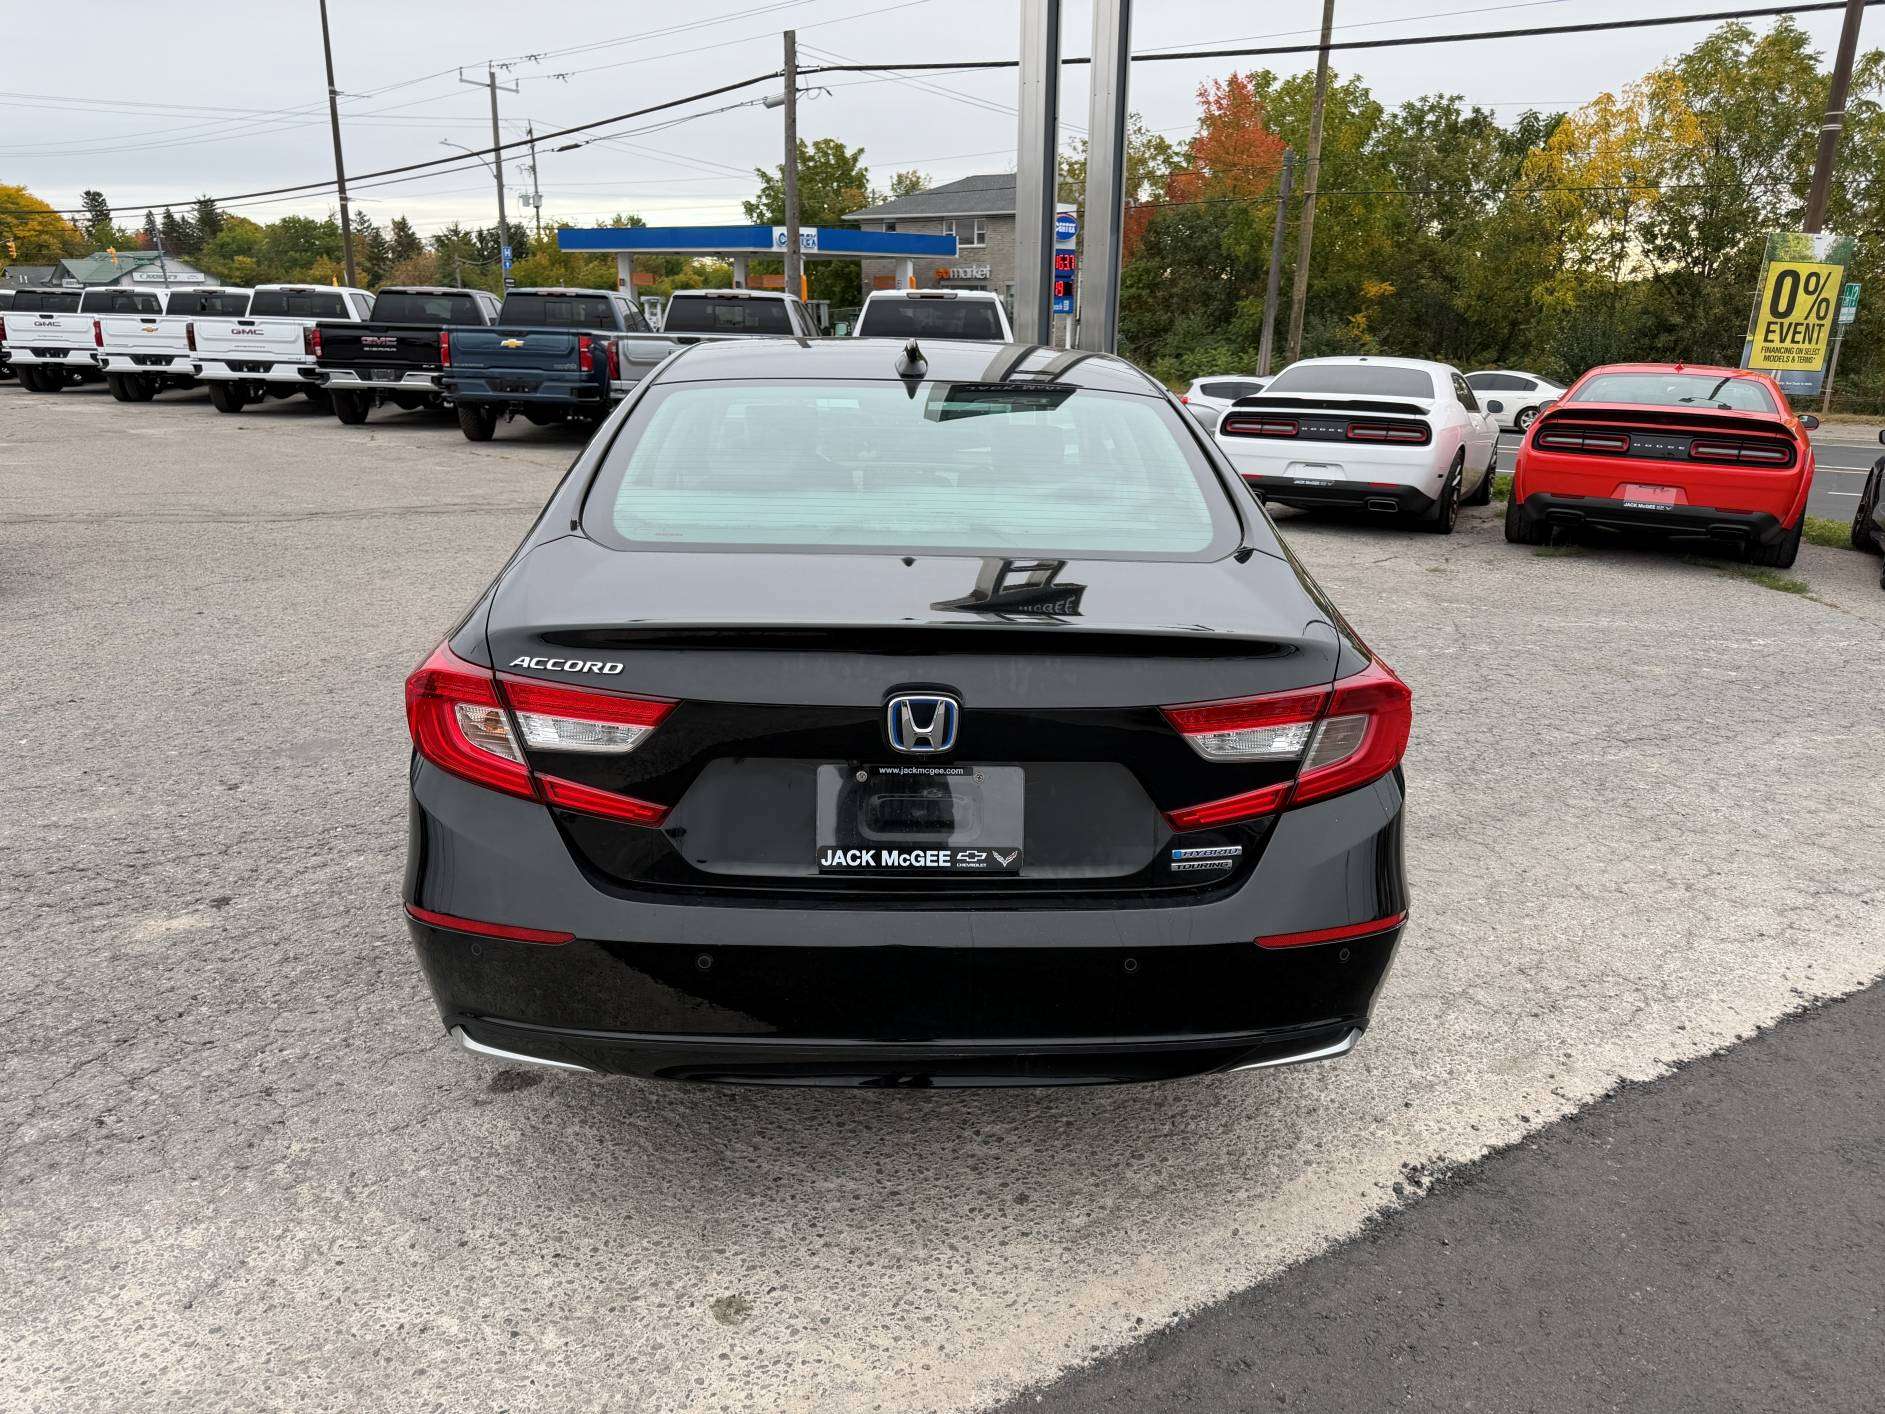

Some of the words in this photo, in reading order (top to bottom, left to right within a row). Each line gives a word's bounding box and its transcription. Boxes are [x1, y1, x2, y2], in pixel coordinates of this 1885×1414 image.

[1769, 269, 1832, 321] 0%
[231, 328, 264, 336] GMC
[1763, 321, 1825, 345] EVENT
[361, 336, 398, 346] GMC
[1760, 346, 1795, 355] FINANCING
[1795, 347, 1804, 355] ON
[1804, 348, 1821, 356] SELECT
[1763, 355, 1790, 363] MODELS
[509, 656, 624, 674] ACCORD
[878, 766, 964, 775] www.jackmcgee.com
[1182, 847, 1240, 857] HYBRID
[820, 850, 876, 867] JACK
[881, 850, 951, 867] McGEE
[1174, 861, 1229, 871] TOURING
